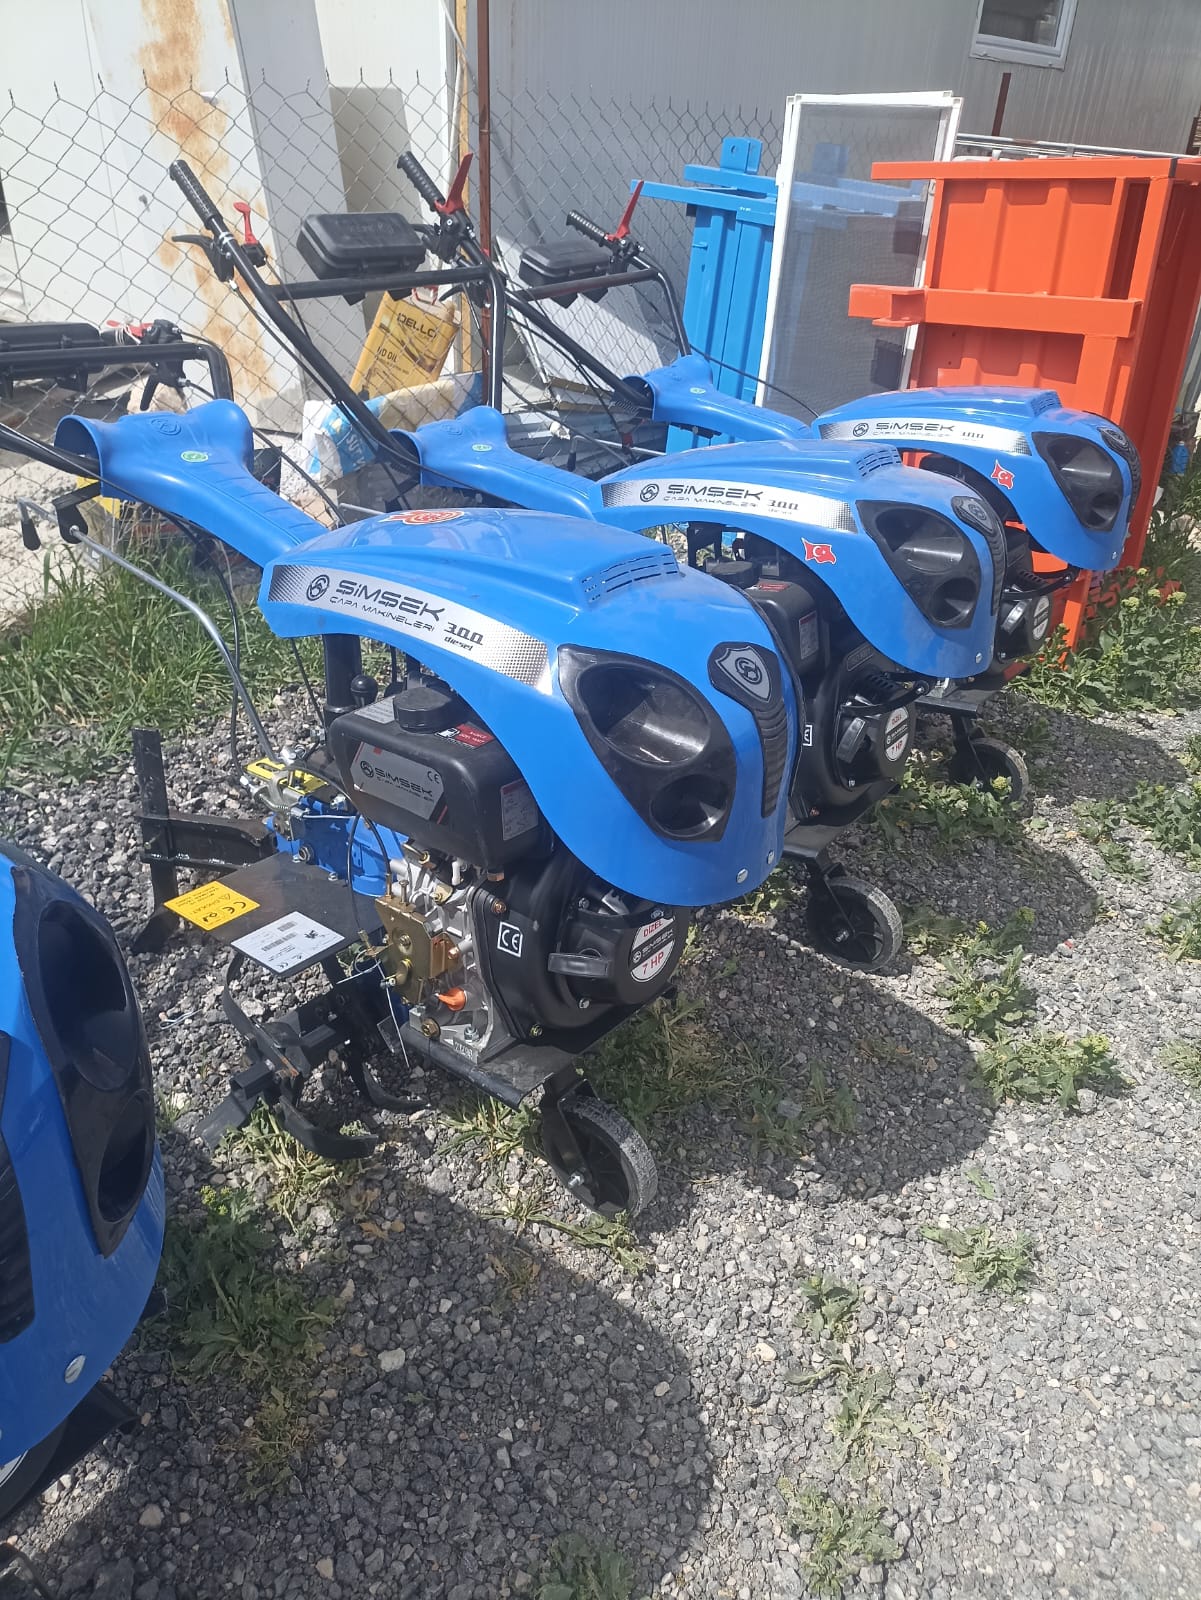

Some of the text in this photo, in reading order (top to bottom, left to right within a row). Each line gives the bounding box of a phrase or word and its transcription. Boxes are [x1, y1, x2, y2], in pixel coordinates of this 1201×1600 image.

[443, 621, 484, 646] 300
[642, 951, 664, 975] 7 HP
